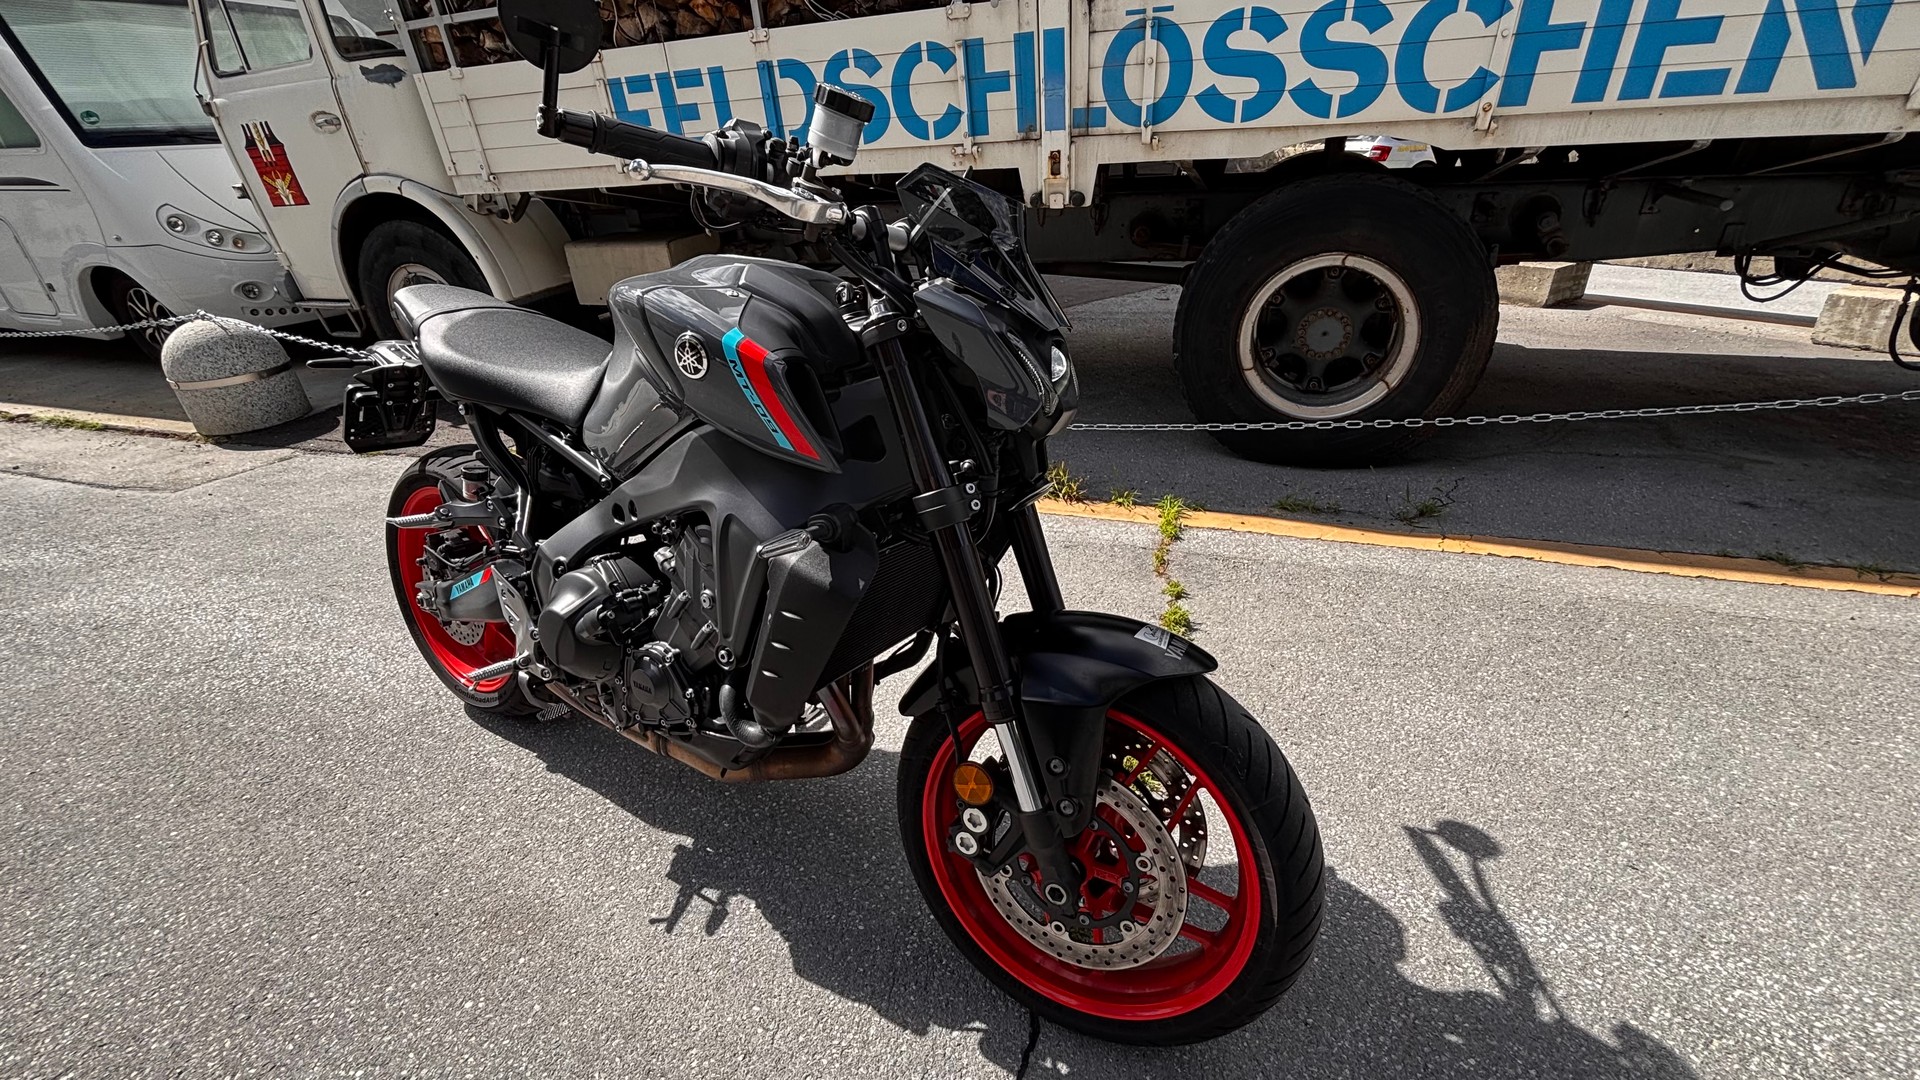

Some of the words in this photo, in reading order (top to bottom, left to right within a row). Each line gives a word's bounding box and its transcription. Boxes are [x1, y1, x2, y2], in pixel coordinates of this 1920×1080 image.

[607, 0, 1895, 147] FELDSCHLÖSSCHEN
[729, 359, 779, 434] MT-09
[454, 577, 475, 595] YAMAHA
[632, 680, 653, 695] YAMAHA
